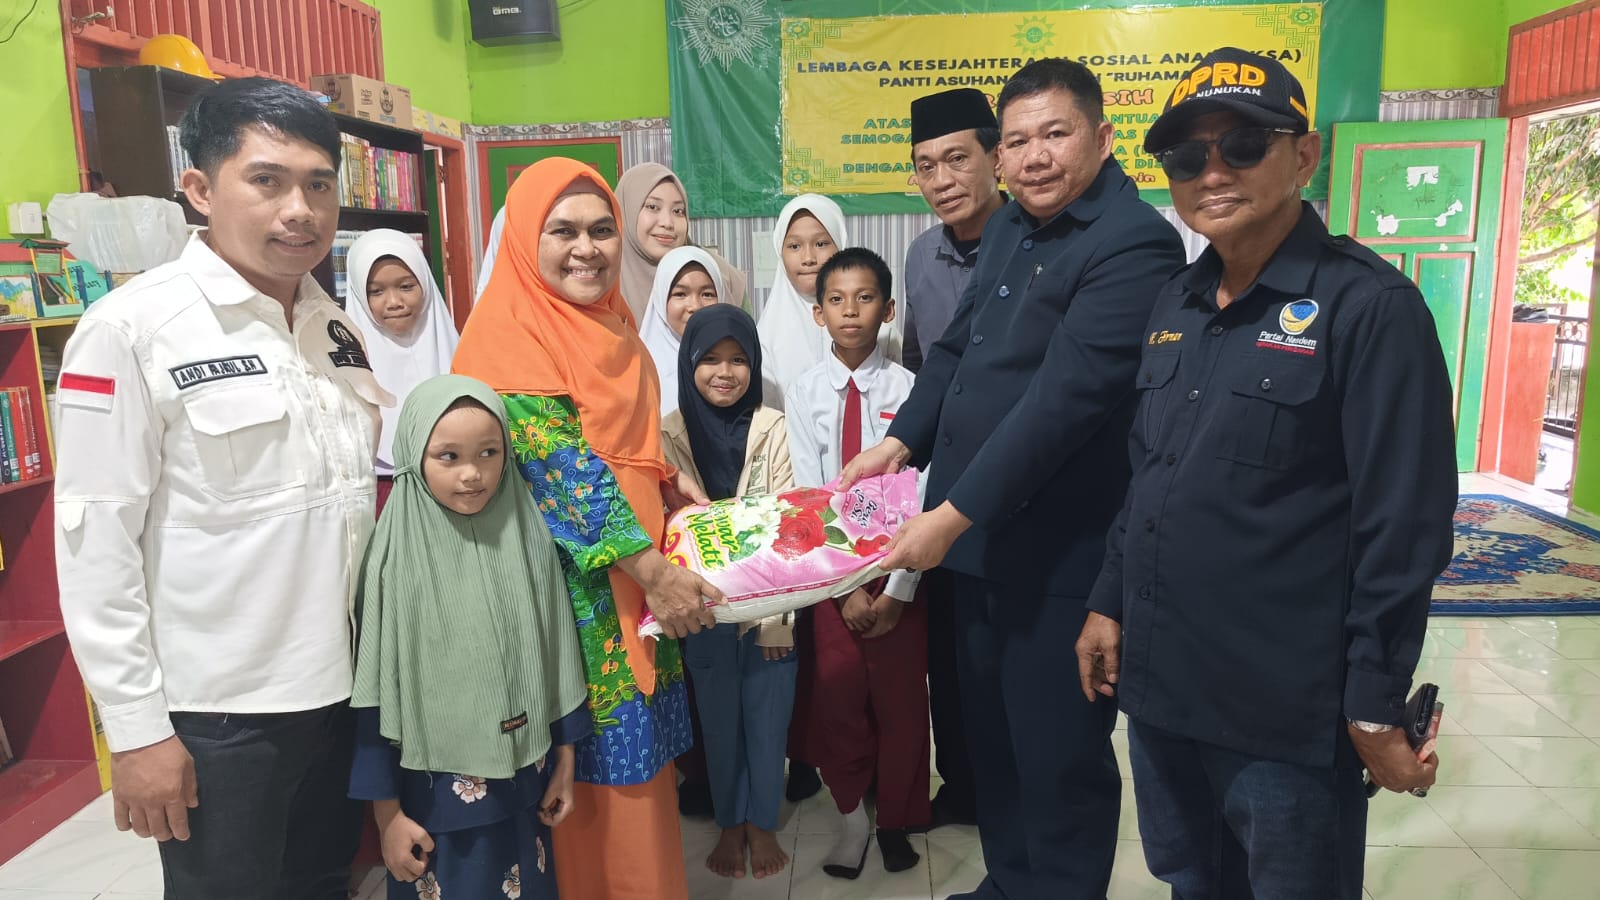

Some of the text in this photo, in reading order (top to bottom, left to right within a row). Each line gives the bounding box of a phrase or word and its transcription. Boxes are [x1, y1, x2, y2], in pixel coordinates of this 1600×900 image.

[797, 60, 892, 73] LEMBAGA
[1078, 54, 1152, 66] SOSIAL
[1160, 52, 1206, 64] ANA
[879, 77, 931, 87] PANTI
[935, 74, 1008, 86] ASUHAN
[1171, 62, 1266, 107] DPRD
[1103, 89, 1154, 106] SIH
[1196, 86, 1261, 97] NUNUKAN
[863, 118, 911, 129] ATAS
[180, 365, 206, 383] ANDI
[685, 512, 726, 569] Melati
